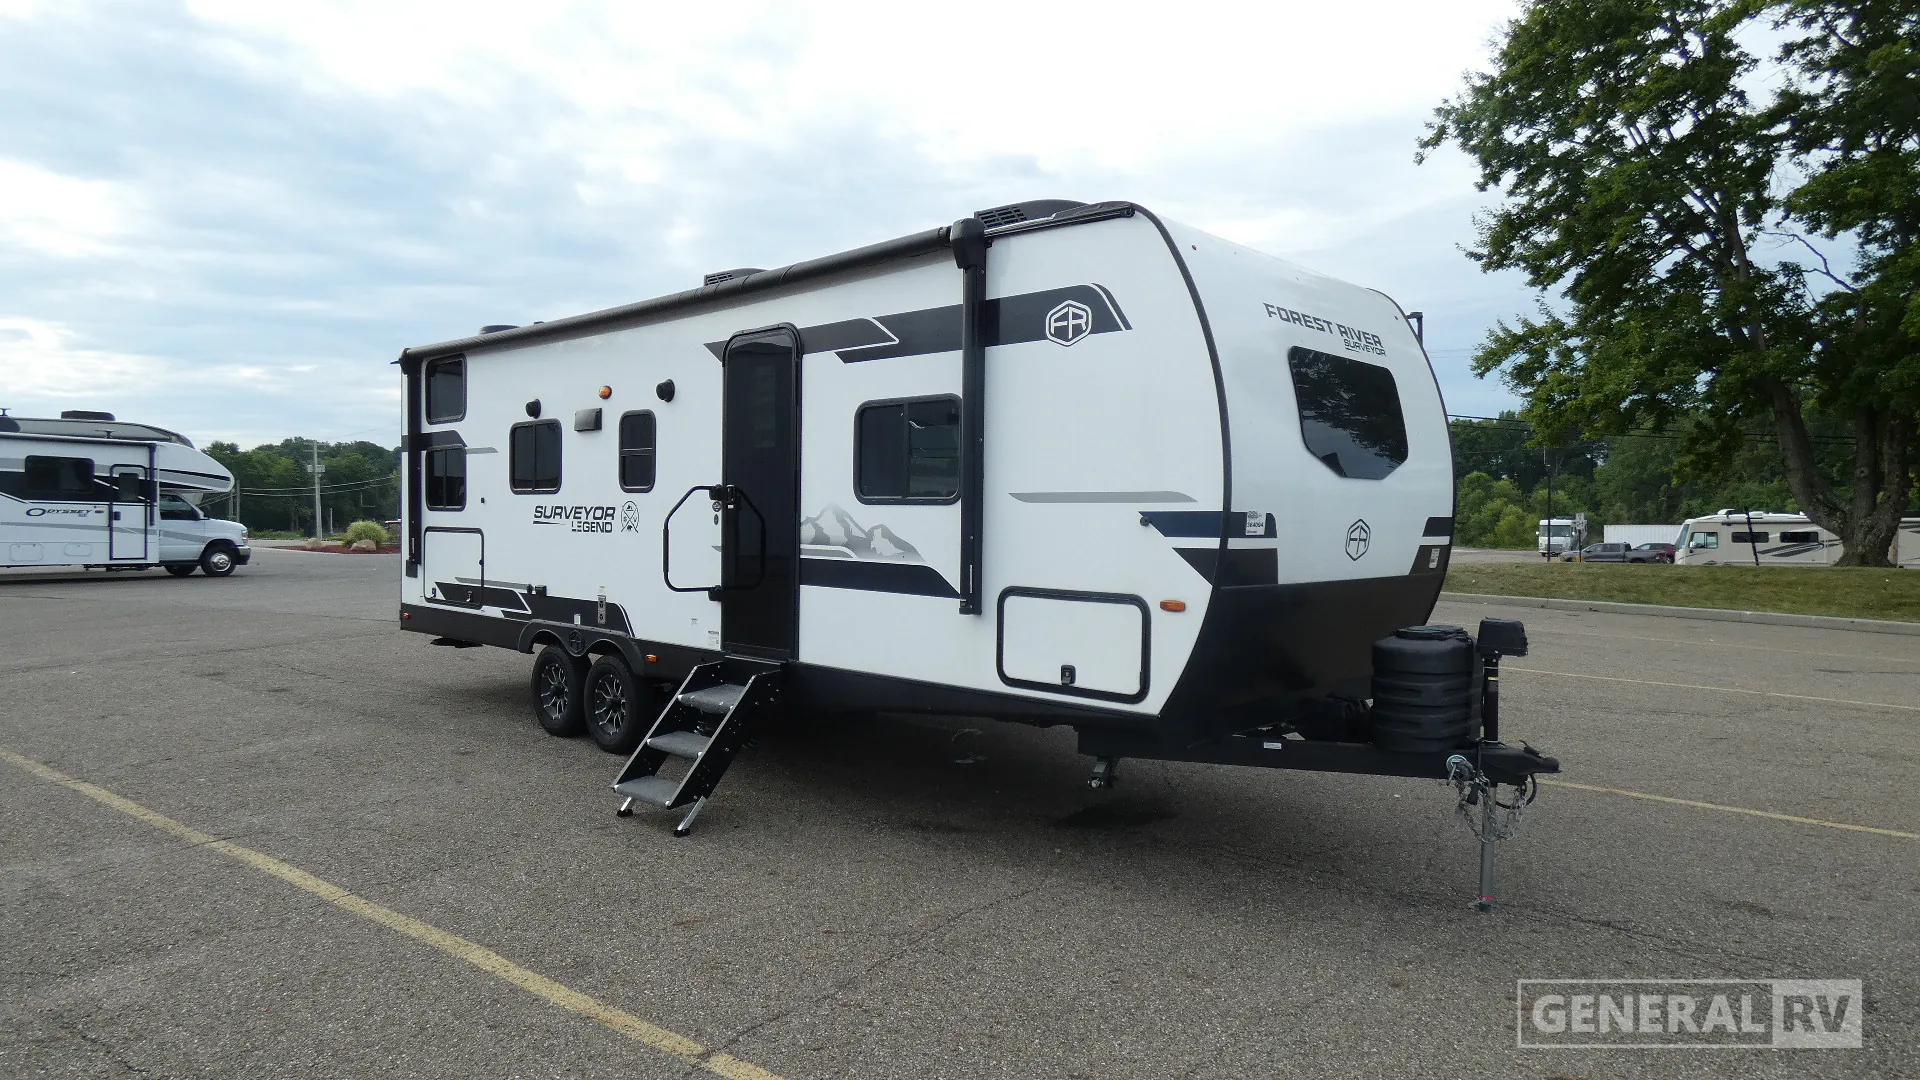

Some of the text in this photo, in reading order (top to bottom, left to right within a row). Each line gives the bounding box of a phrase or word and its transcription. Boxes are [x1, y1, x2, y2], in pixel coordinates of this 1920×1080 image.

[1263, 302, 1384, 349] FOREST RIVER
[1343, 339, 1387, 357] SURVEYOR
[26, 508, 92, 517] ODYSSEY
[533, 505, 616, 521] SURVEYOR
[571, 520, 613, 533] LEGEND
